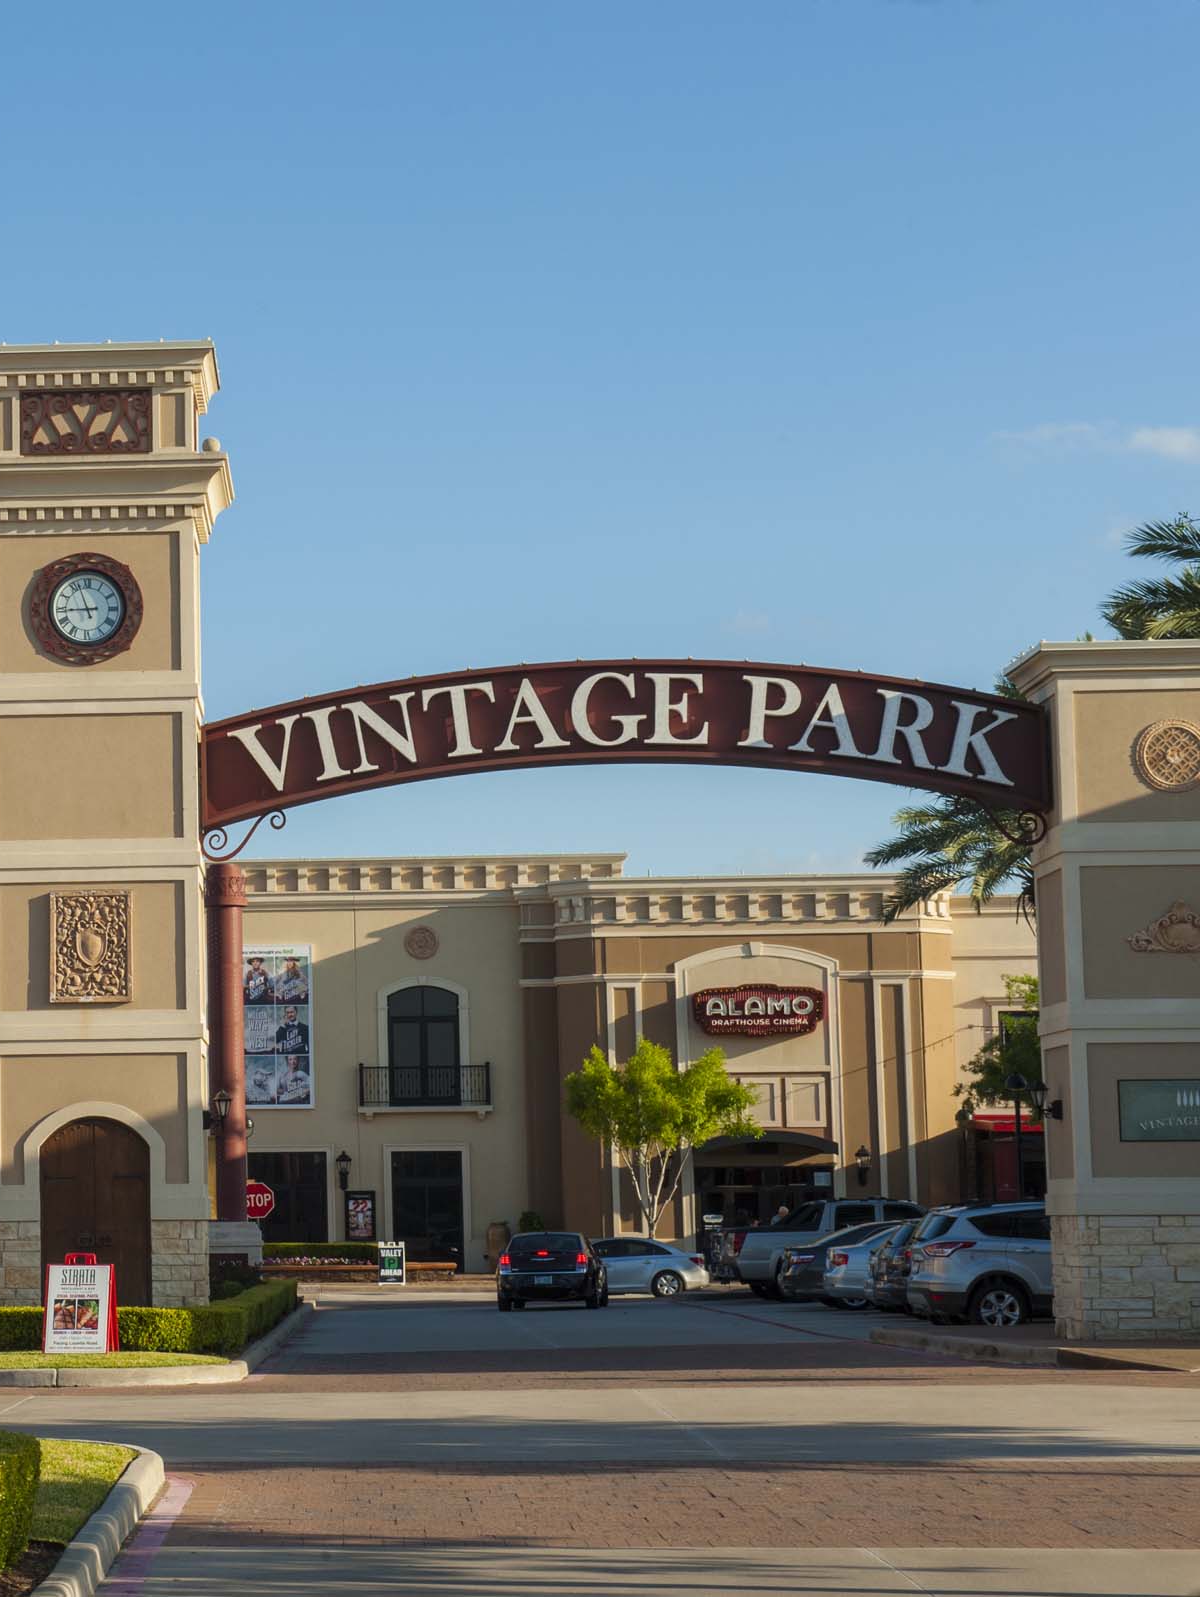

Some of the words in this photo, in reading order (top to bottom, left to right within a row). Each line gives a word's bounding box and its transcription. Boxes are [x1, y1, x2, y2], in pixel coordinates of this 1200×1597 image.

[226, 671, 709, 793] VINTAGE
[736, 673, 1018, 788] PARK
[706, 995, 814, 1016] ALAMO
[711, 1018, 772, 1026] DRAFTHOUSE
[352, 1200, 369, 1212] 22
[380, 1249, 402, 1257] VALET
[61, 1269, 96, 1287] STRATA
